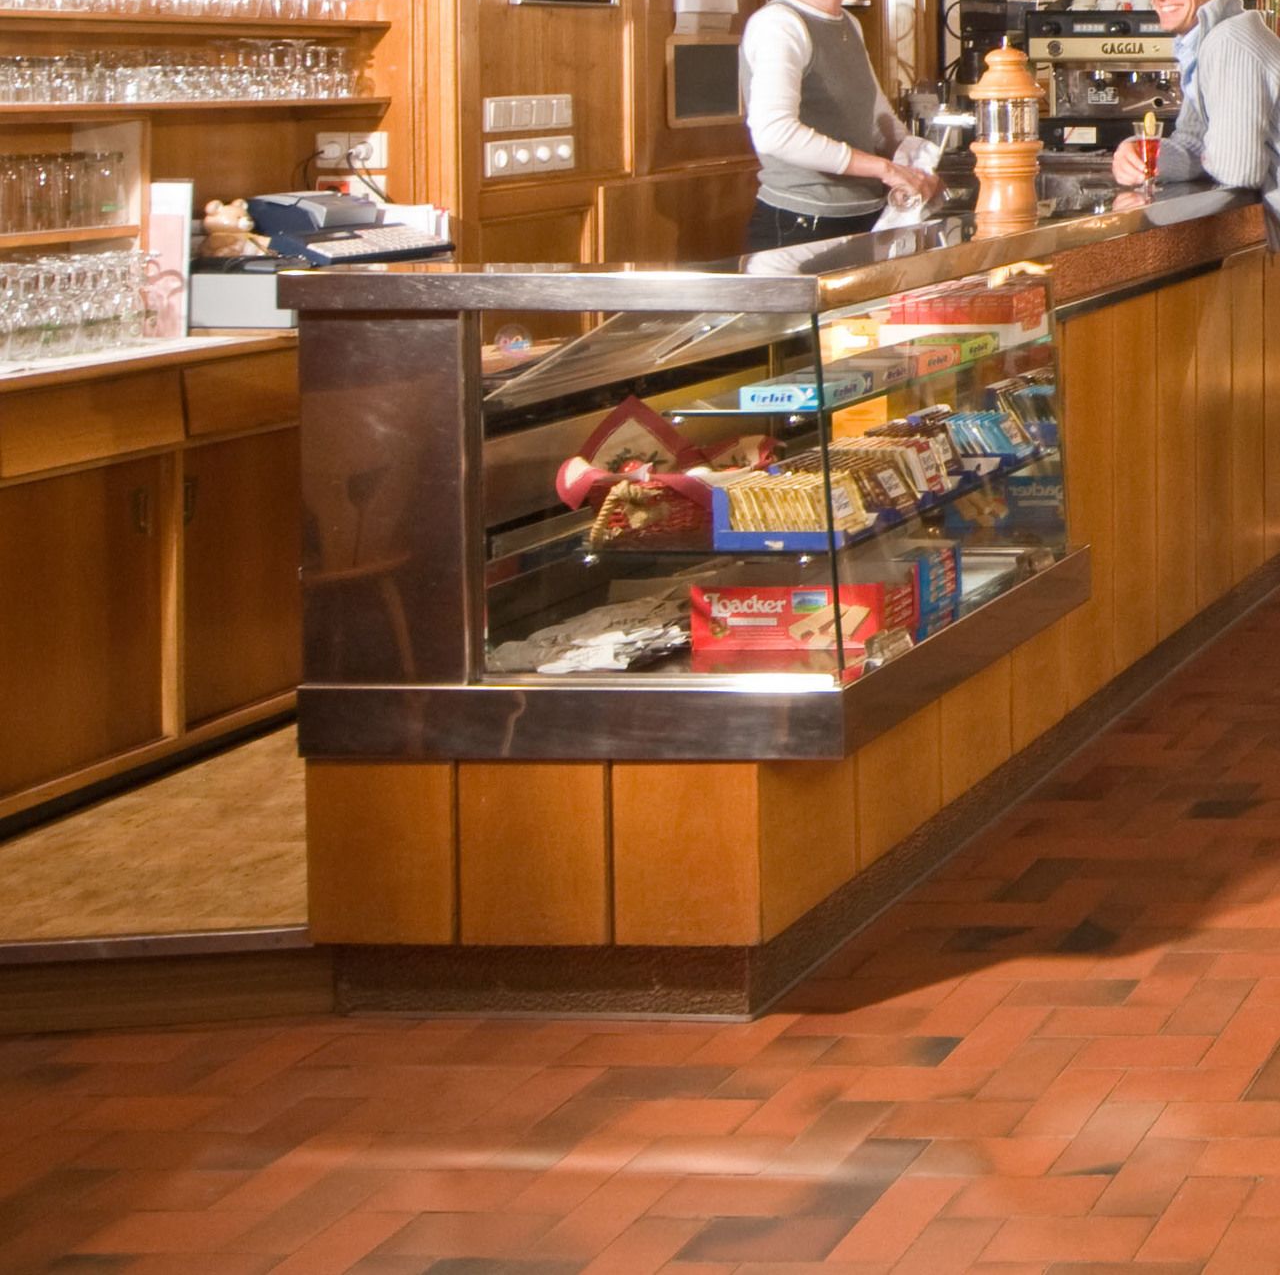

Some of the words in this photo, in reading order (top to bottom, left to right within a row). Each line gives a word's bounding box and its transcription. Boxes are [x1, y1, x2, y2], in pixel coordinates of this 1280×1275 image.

[1101, 42, 1145, 55] GAGGIA
[750, 391, 794, 404] Orbit
[703, 592, 787, 618] Loacker
